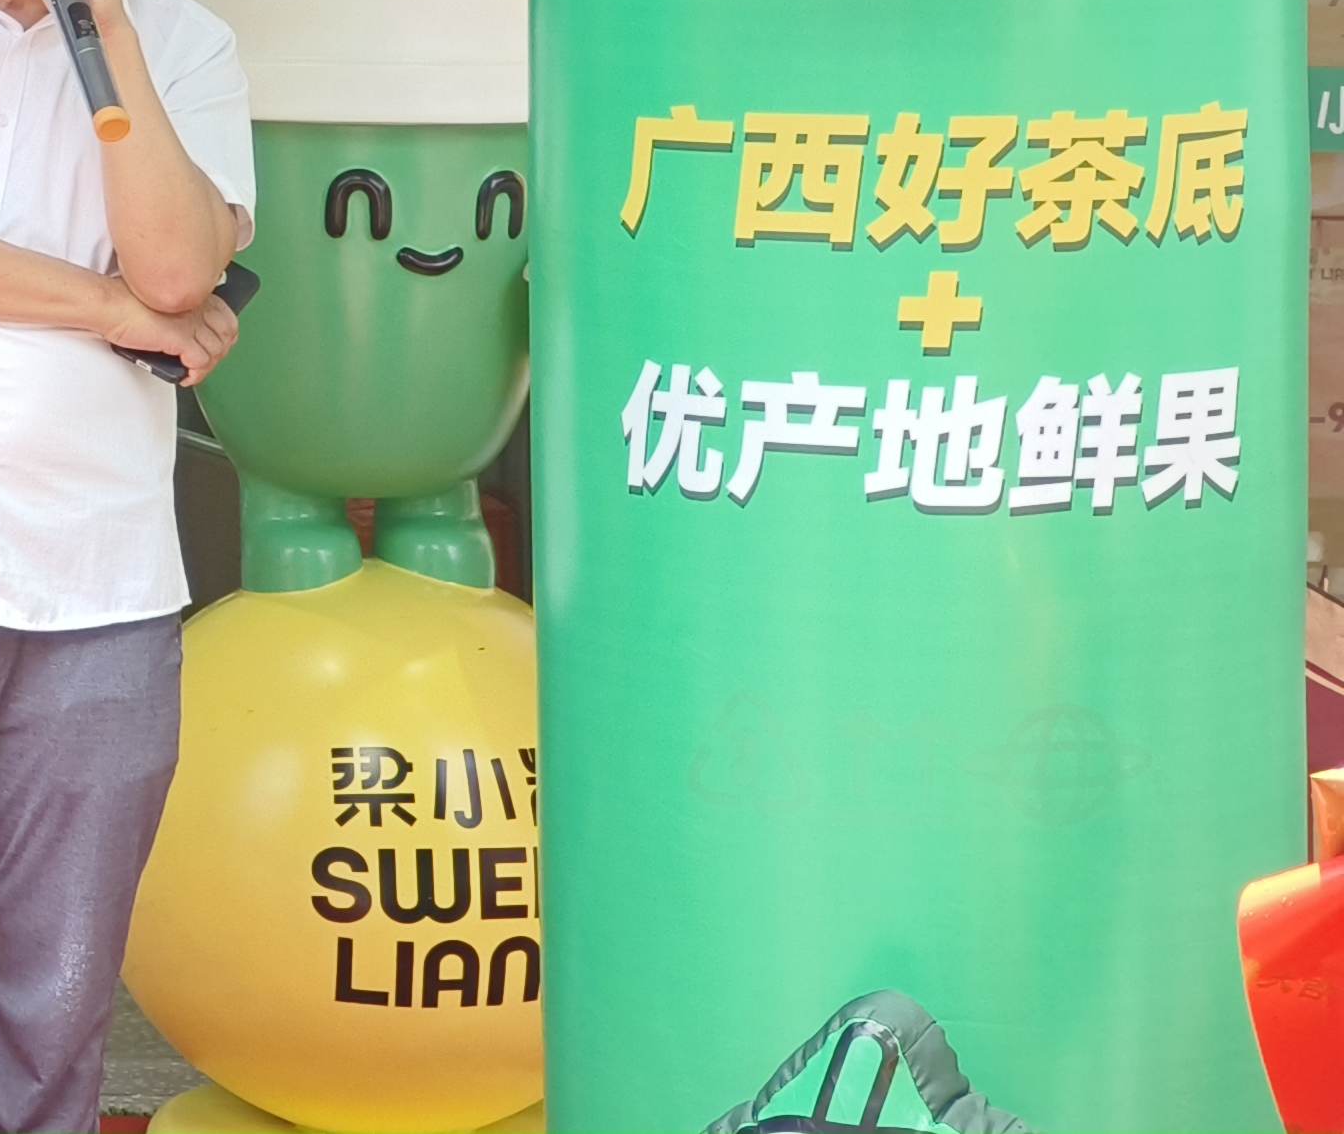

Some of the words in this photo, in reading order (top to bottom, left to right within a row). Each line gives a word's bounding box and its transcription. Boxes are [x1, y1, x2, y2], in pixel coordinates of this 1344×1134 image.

[620, 101, 1249, 250] 广西好茶底
[620, 359, 1242, 515] 优产地鲜果
[311, 846, 540, 925] SWE
